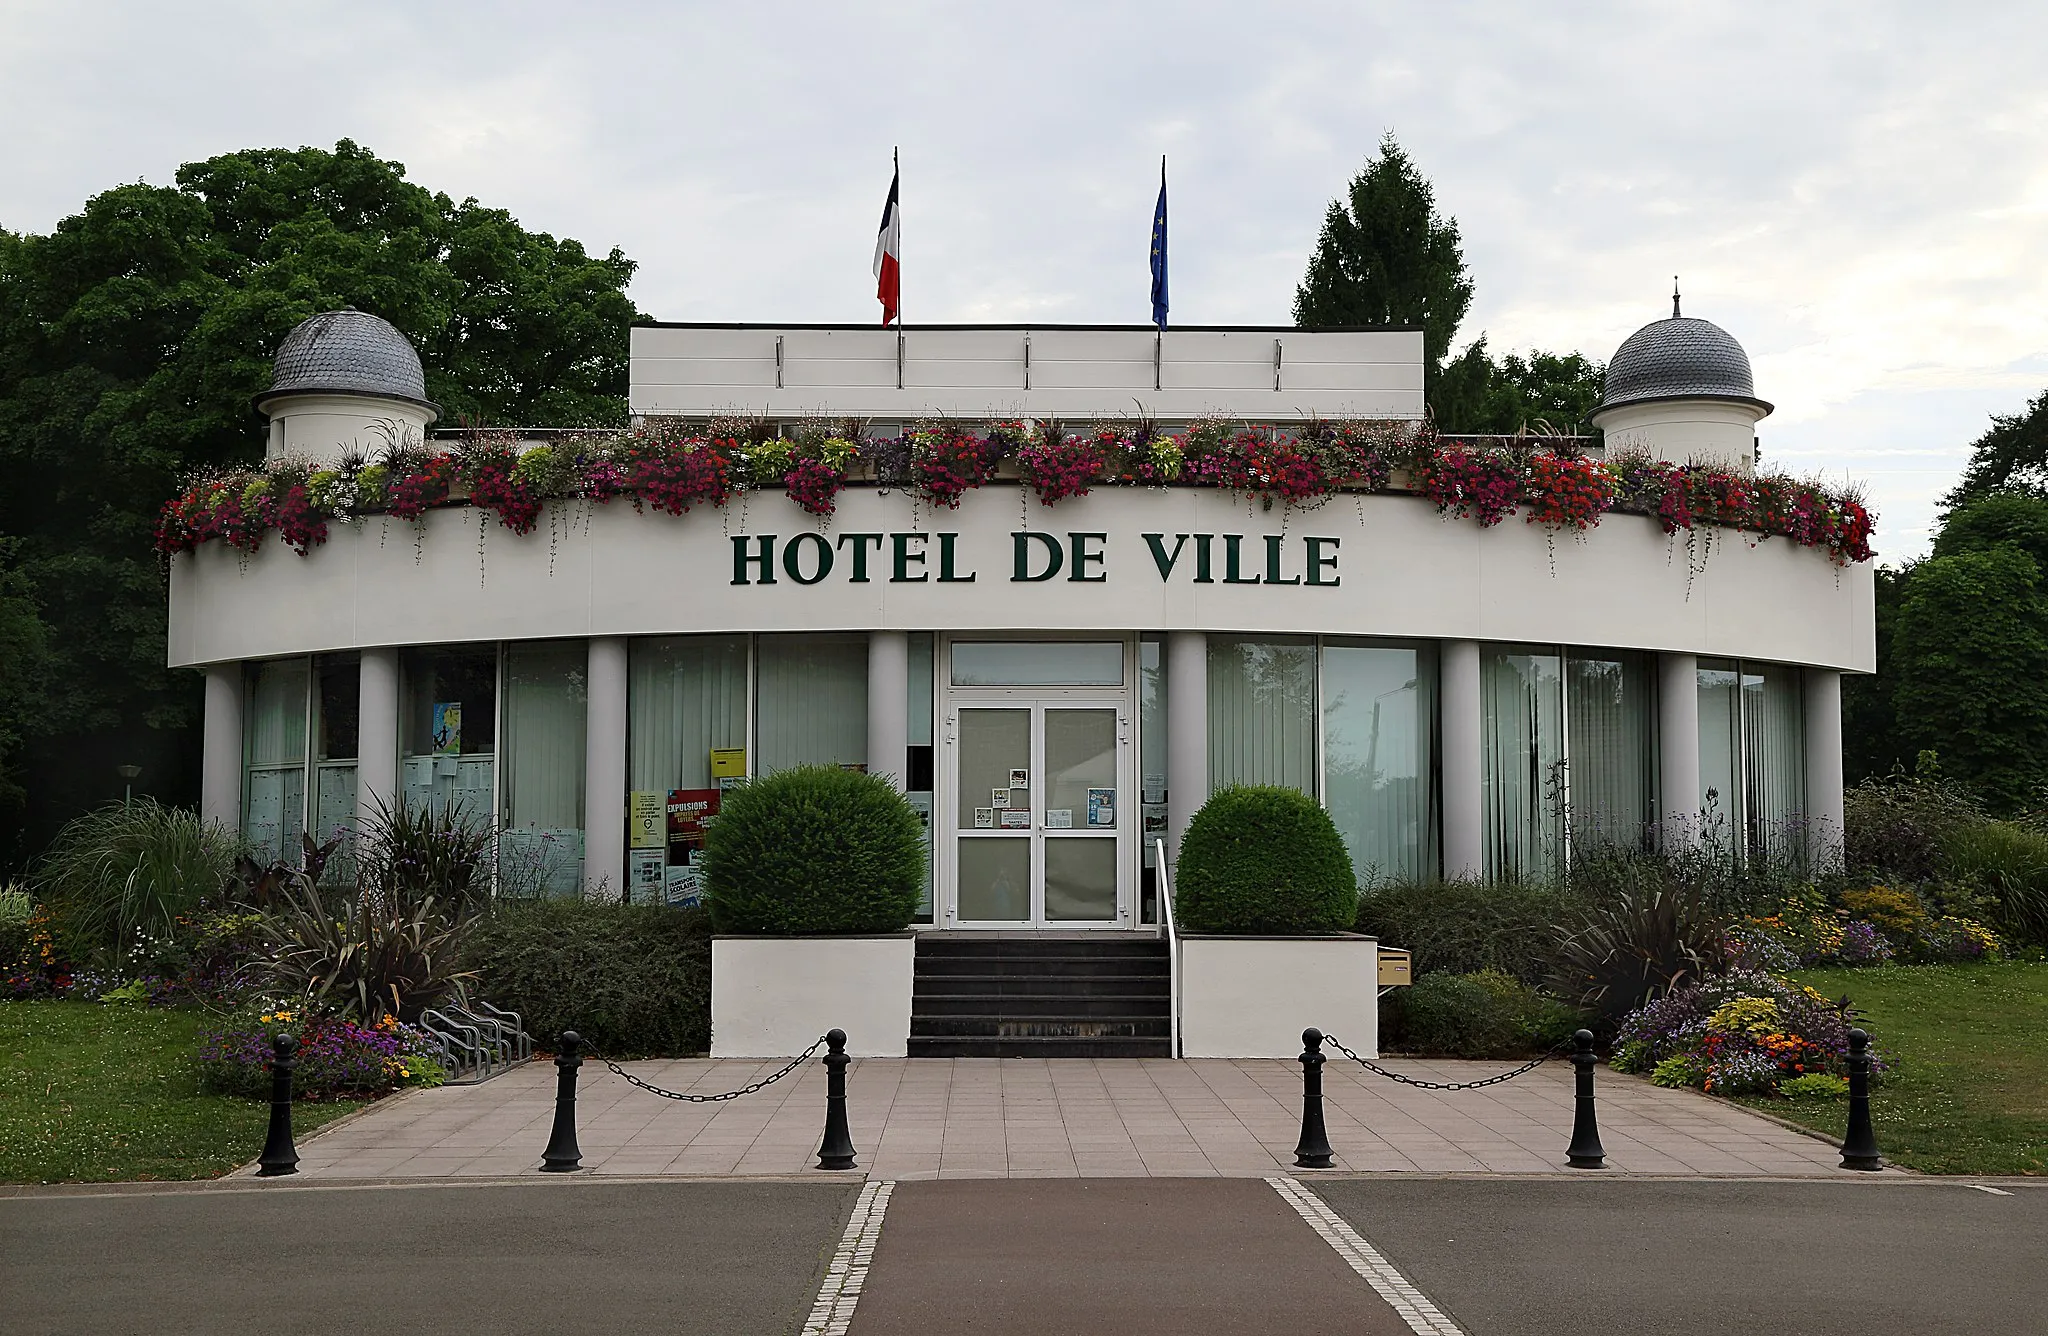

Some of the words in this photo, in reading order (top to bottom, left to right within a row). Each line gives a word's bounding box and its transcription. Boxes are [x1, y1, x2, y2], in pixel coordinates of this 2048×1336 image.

[729, 532, 977, 585] HOTEL
[1009, 531, 1108, 583] DE
[1140, 533, 1341, 586] VILLE
[668, 801, 708, 813] EXPULSIONS
[669, 876, 696, 888] TRANSPORT
[669, 881, 697, 894] SCOLAIRE
